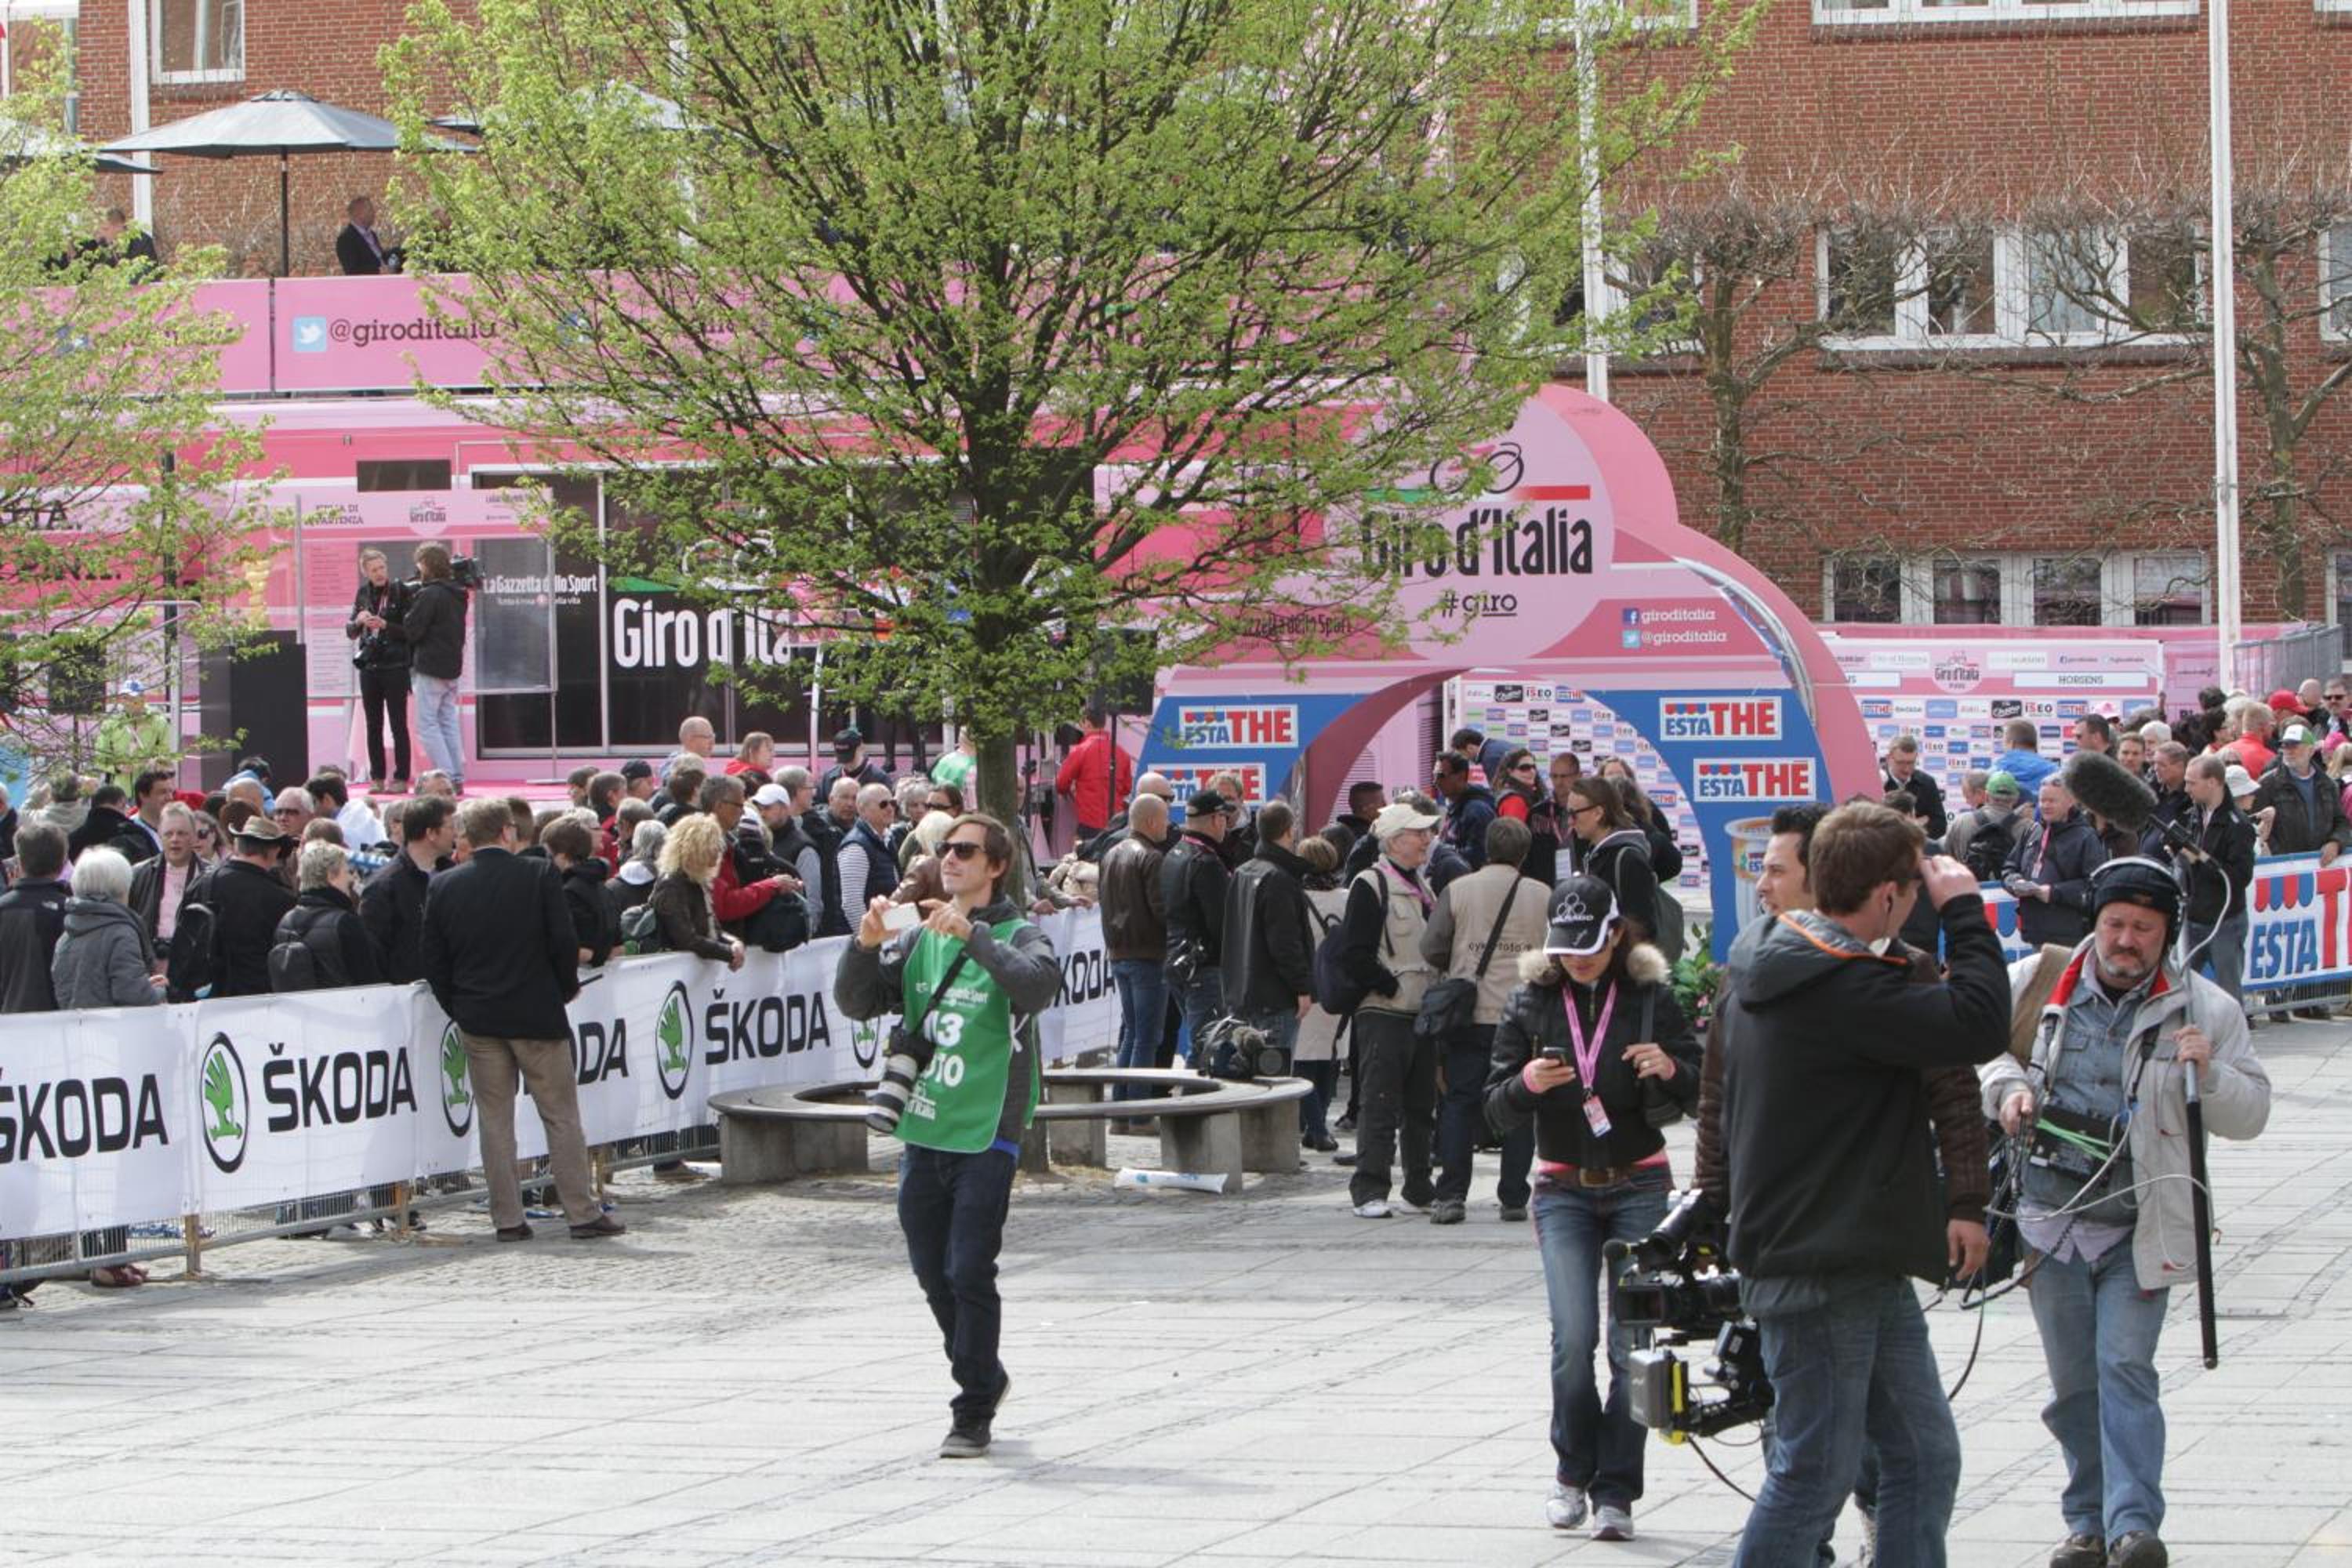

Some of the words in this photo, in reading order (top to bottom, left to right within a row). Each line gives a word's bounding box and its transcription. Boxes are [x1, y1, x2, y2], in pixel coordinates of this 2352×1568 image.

[1456, 506, 1592, 575] d'Italia
[543, 575, 568, 593] dllo
[568, 574, 598, 596] Sport
[614, 598, 699, 668] Giro
[1641, 608, 1715, 624] giroditalia
[1642, 630, 1728, 646] @giroditalia
[1526, 686, 1552, 698] ISEO
[2058, 675, 2103, 685] HORSENS
[2025, 702, 2053, 713] ISEO
[2250, 918, 2318, 979] ESTA
[1053, 949, 1116, 1007] KODA
[706, 989, 831, 1066] ŠKODA
[263, 1043, 418, 1133] ŠKODA
